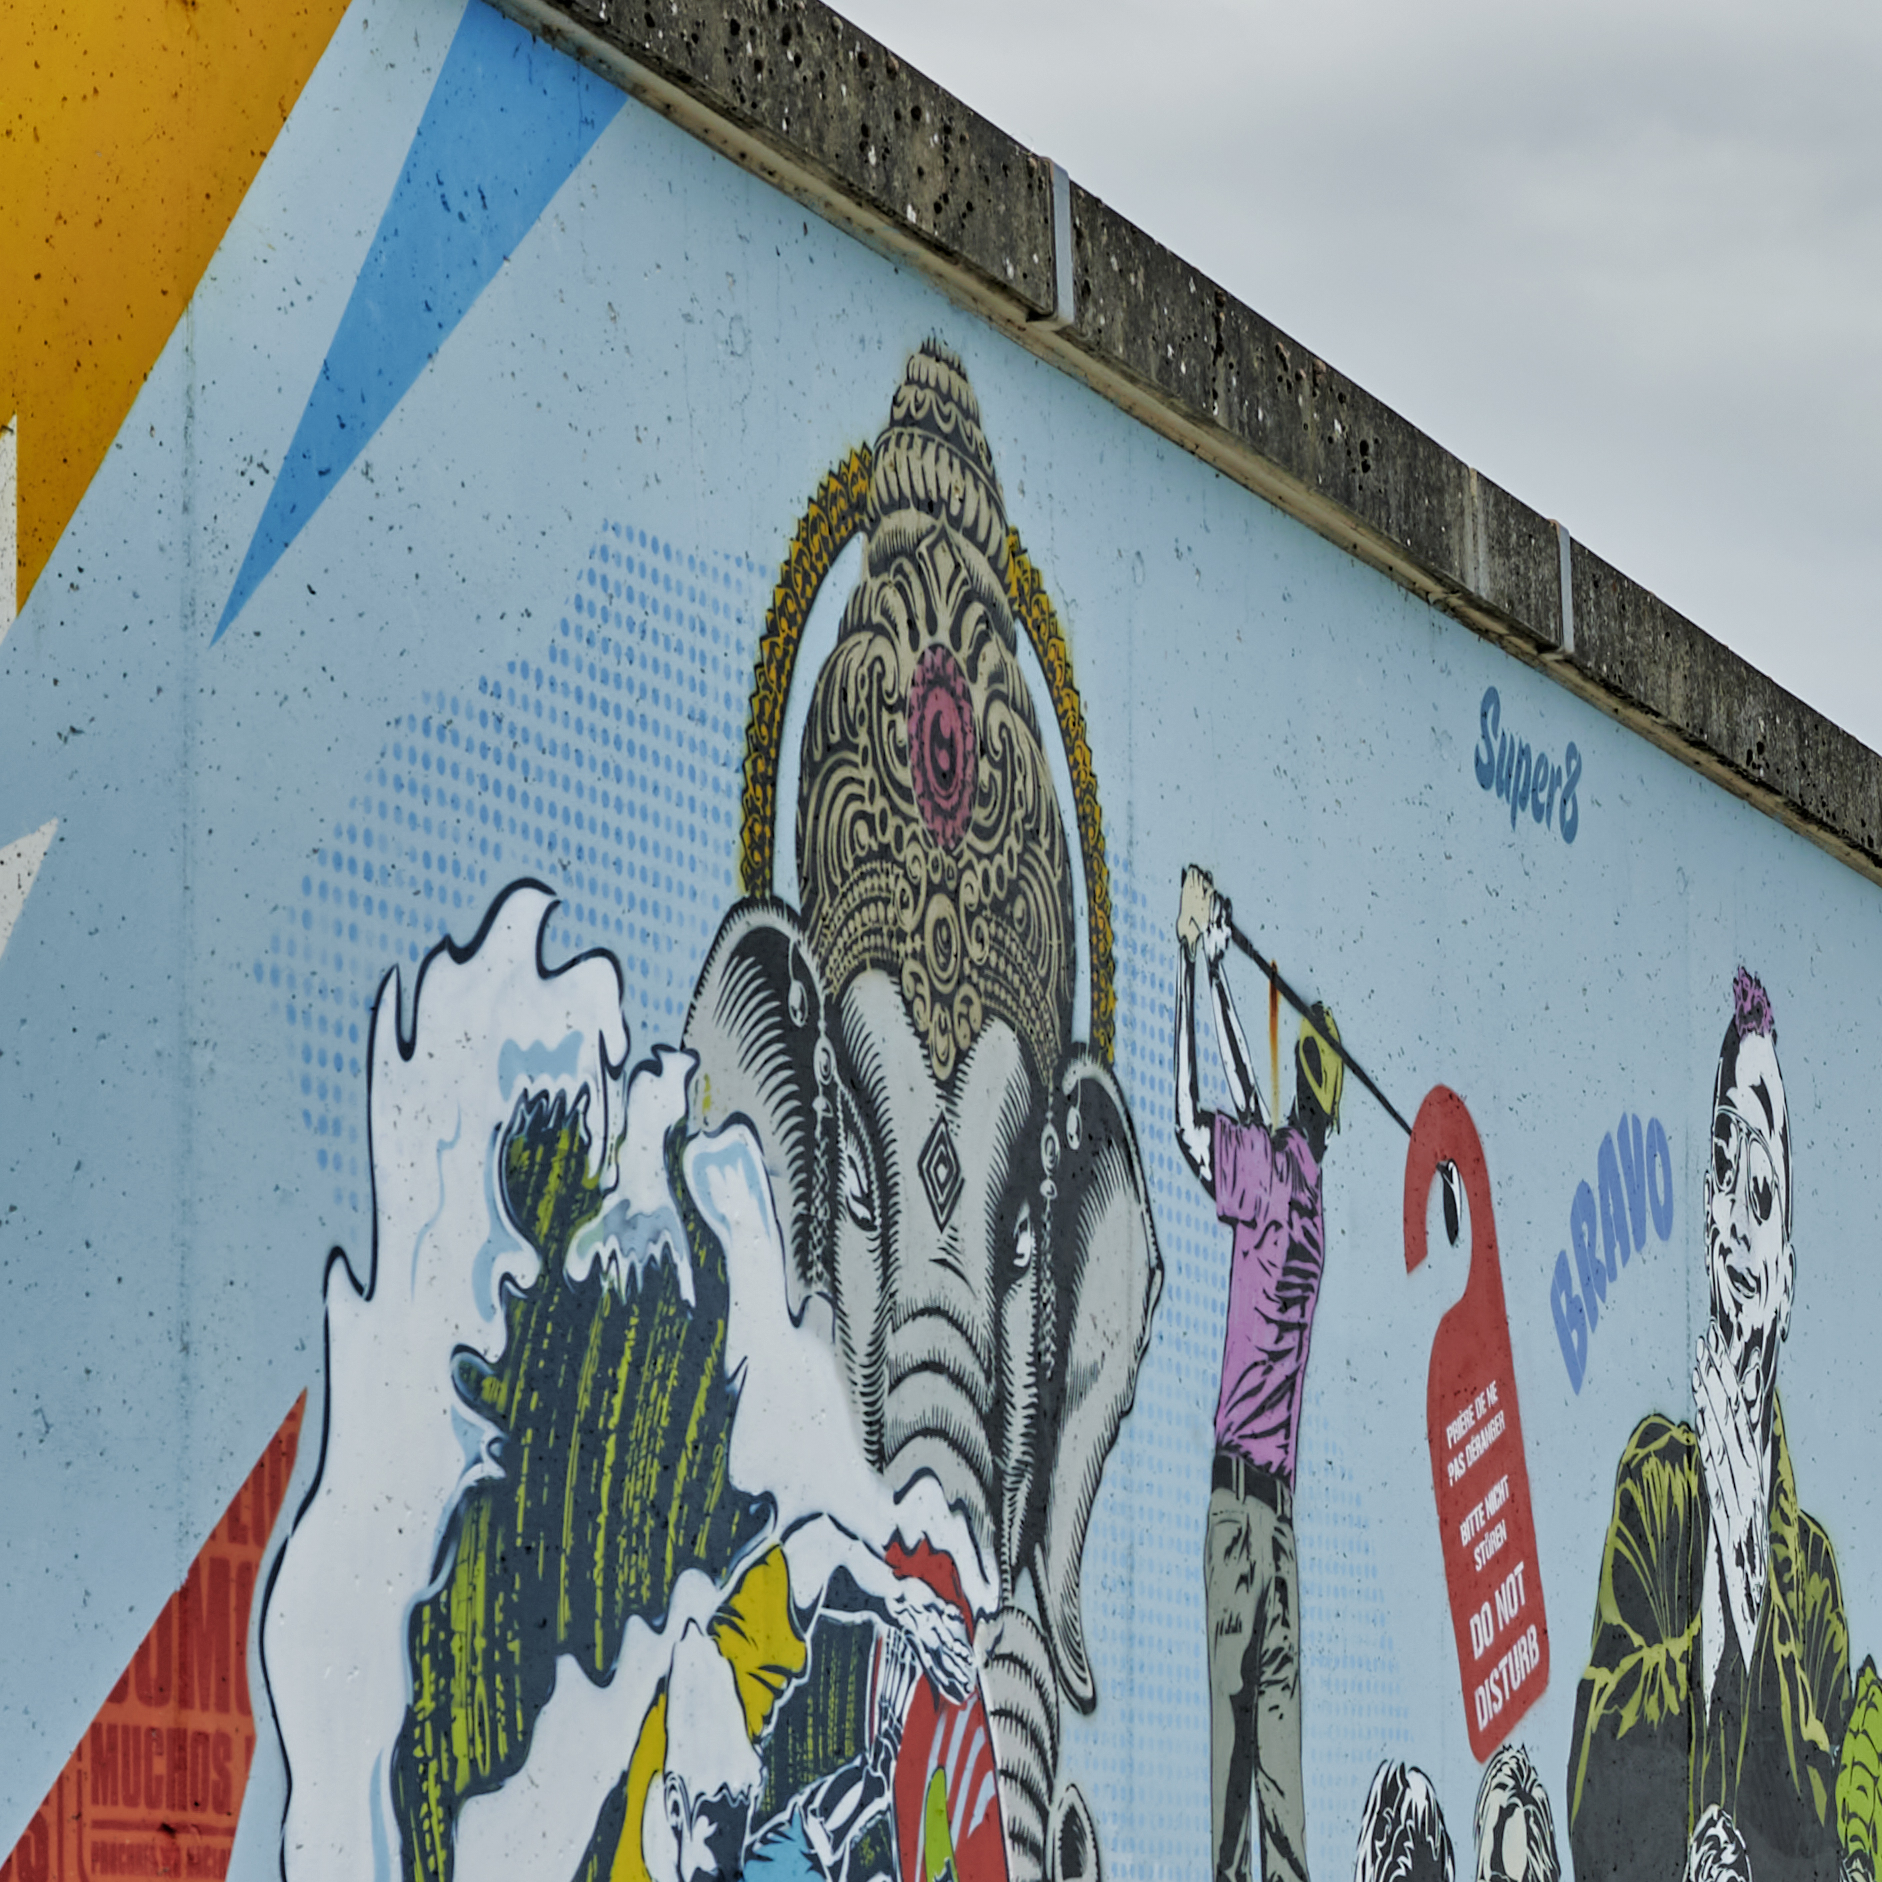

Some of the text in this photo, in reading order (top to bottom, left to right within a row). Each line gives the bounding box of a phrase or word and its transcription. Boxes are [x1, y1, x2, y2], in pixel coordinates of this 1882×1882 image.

[1550, 1111, 1674, 1396] BRAVO
[1474, 1391, 1487, 1420] DE
[1486, 1379, 1499, 1408] NE
[1447, 1451, 1467, 1487] PAS
[1459, 1474, 1510, 1547] BITTE NICHT
[1468, 1560, 1526, 1661] DO NOT
[1473, 1623, 1540, 1732] DISTURB
[90, 1721, 233, 1816] MUCHOS
